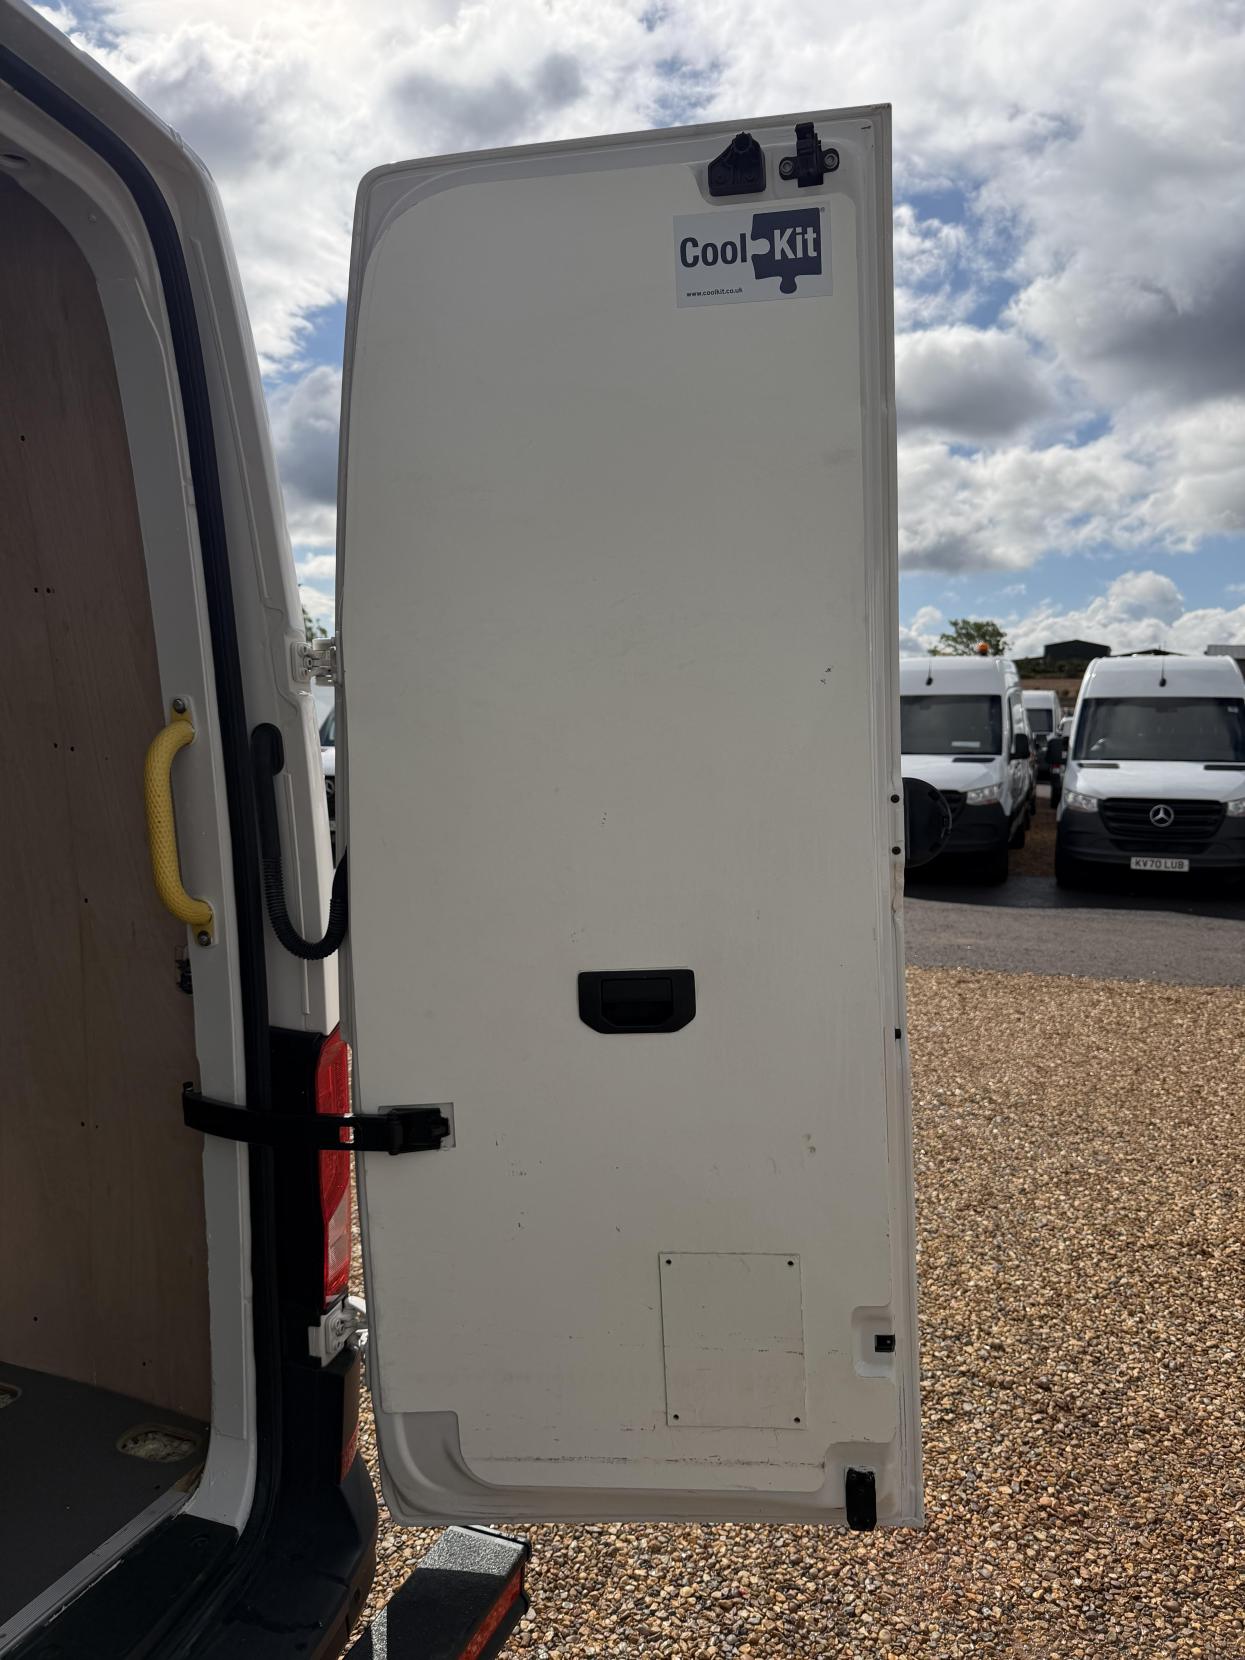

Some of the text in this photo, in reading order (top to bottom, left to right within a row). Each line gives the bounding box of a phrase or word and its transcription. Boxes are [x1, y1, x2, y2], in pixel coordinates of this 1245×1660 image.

[679, 226, 817, 268] Cool Kit
[686, 287, 743, 297] www.coolkit.co.uk
[1134, 859, 1162, 869] KV70
